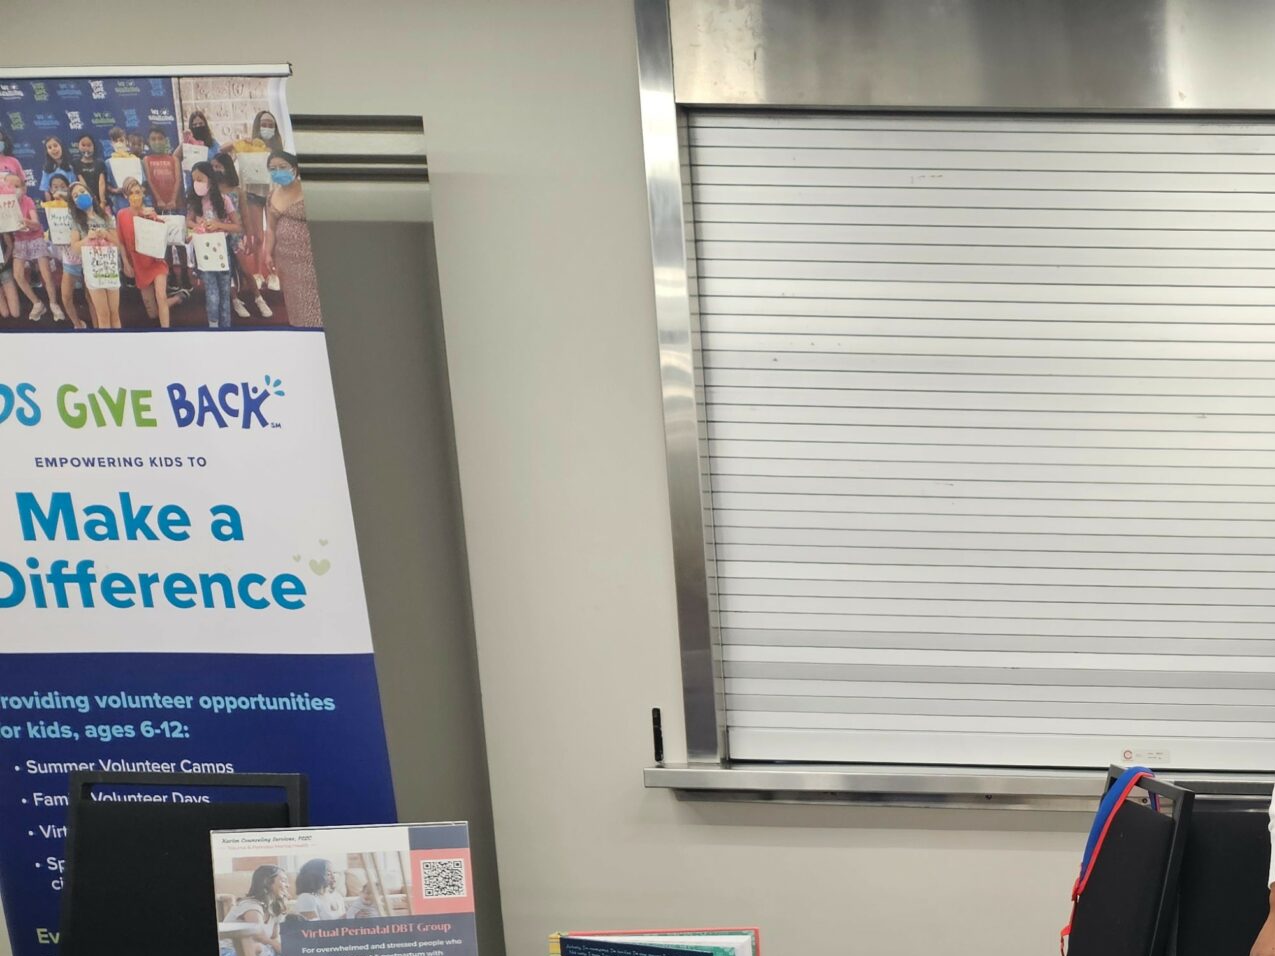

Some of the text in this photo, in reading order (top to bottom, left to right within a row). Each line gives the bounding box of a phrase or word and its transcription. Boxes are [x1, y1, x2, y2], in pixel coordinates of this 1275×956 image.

[56, 383, 157, 429] GIVE
[166, 381, 271, 430] BACK
[35, 457, 207, 468] EMPOWERING KIDS TO
[15, 491, 244, 541] Make a
[0, 556, 307, 610] Difference
[94, 692, 193, 710] volunteer
[199, 693, 336, 713] opportunities
[26, 721, 79, 741] kids,
[85, 725, 135, 743] ages
[140, 721, 190, 739] 6-12:
[26, 759, 234, 774] Summer Volunteer Camps
[300, 922, 452, 939] Virtual Perinatal DBT Group
[316, 944, 369, 954] overwhelmed
[418, 939, 444, 949] people
